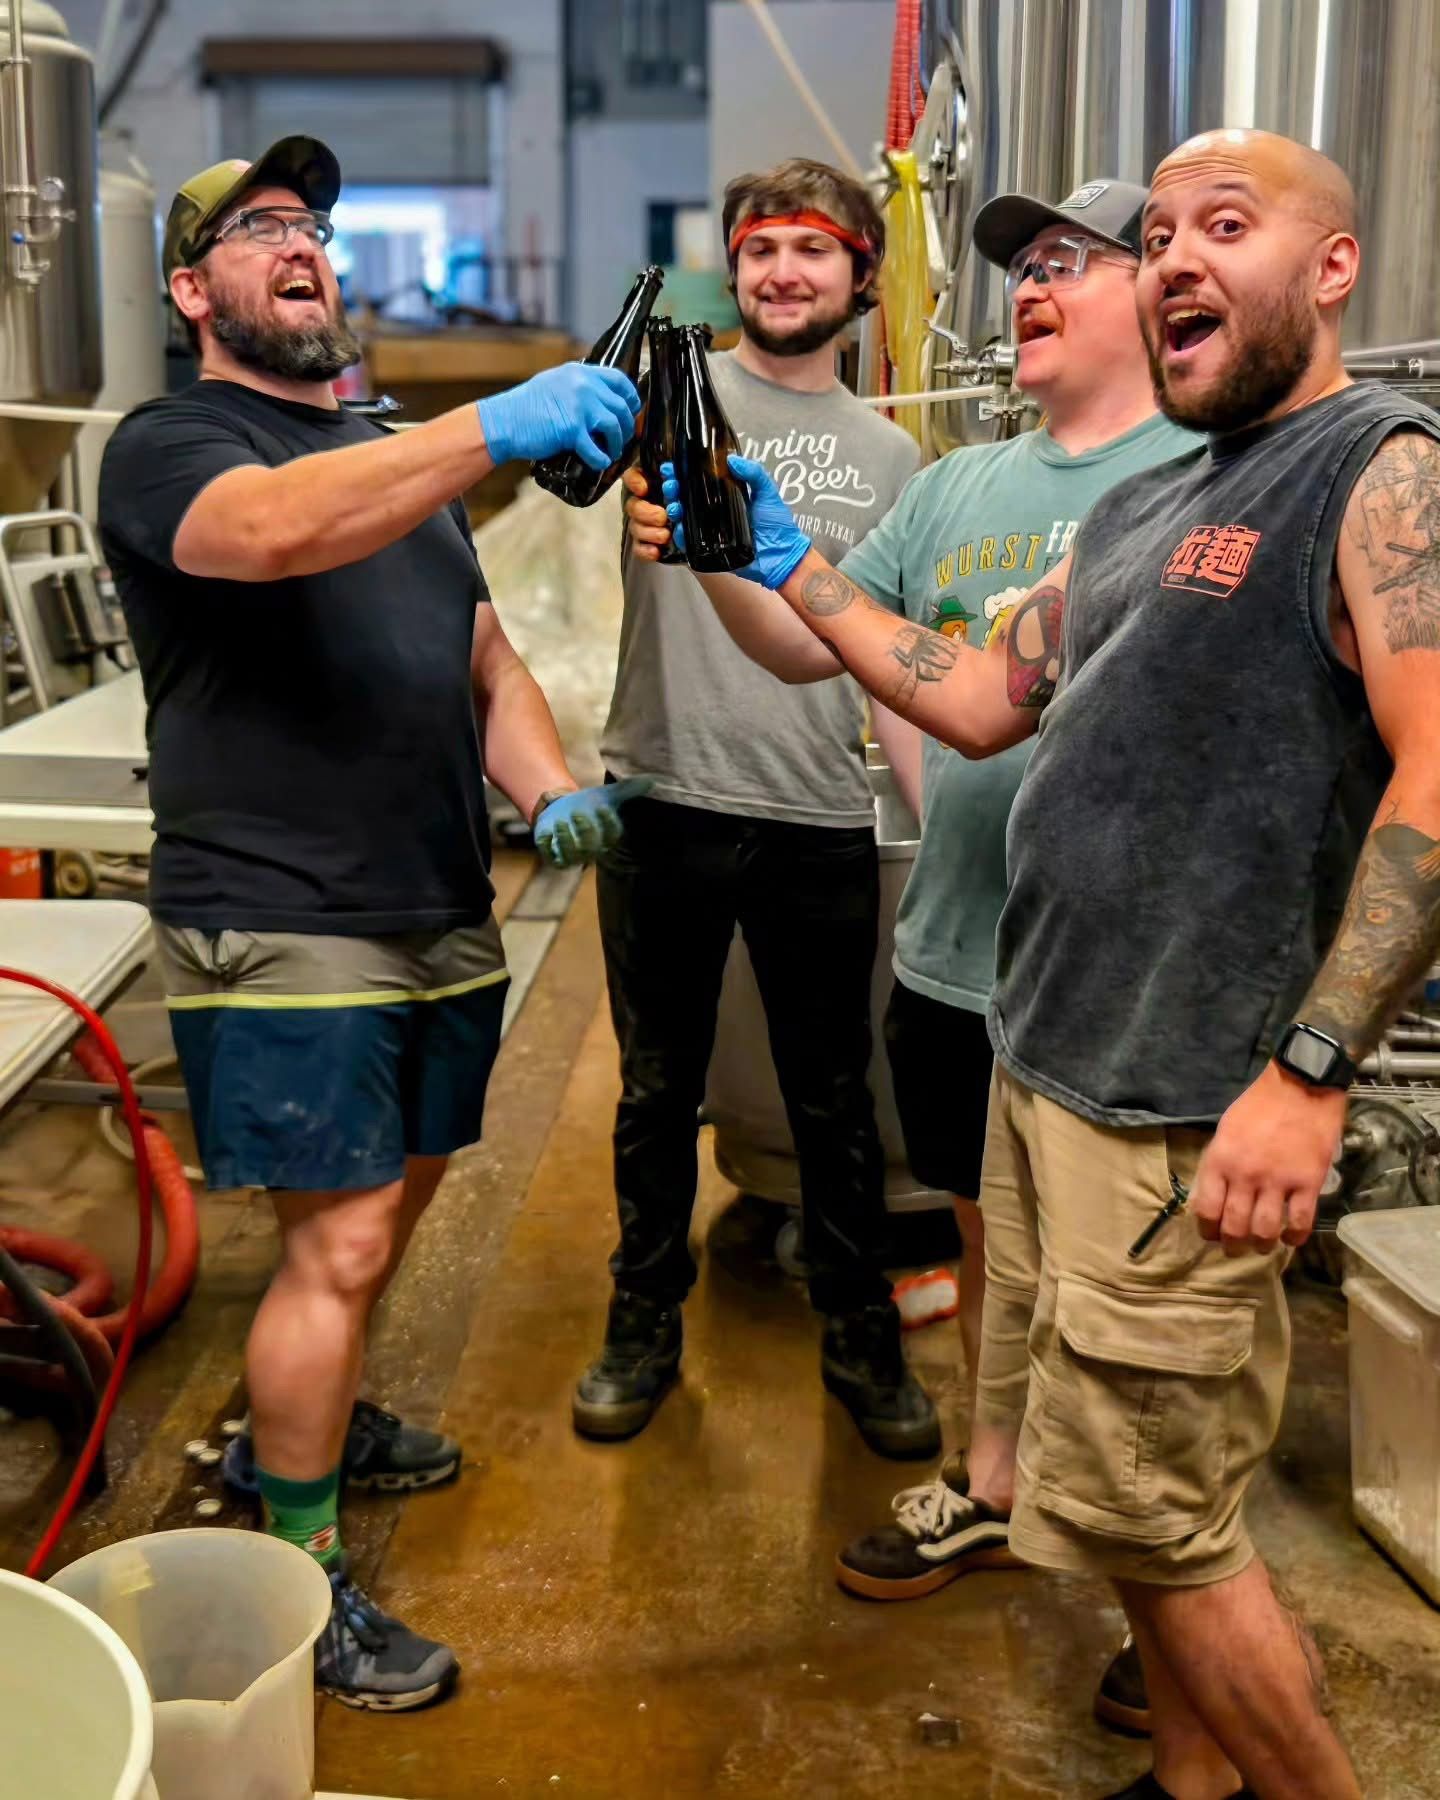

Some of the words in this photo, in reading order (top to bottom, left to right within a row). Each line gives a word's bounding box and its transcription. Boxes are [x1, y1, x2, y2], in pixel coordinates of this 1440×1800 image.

[737, 428, 838, 468] rning
[774, 460, 876, 508] Beer
[936, 532, 1044, 588] WURST
[1046, 520, 1079, 553] FR
